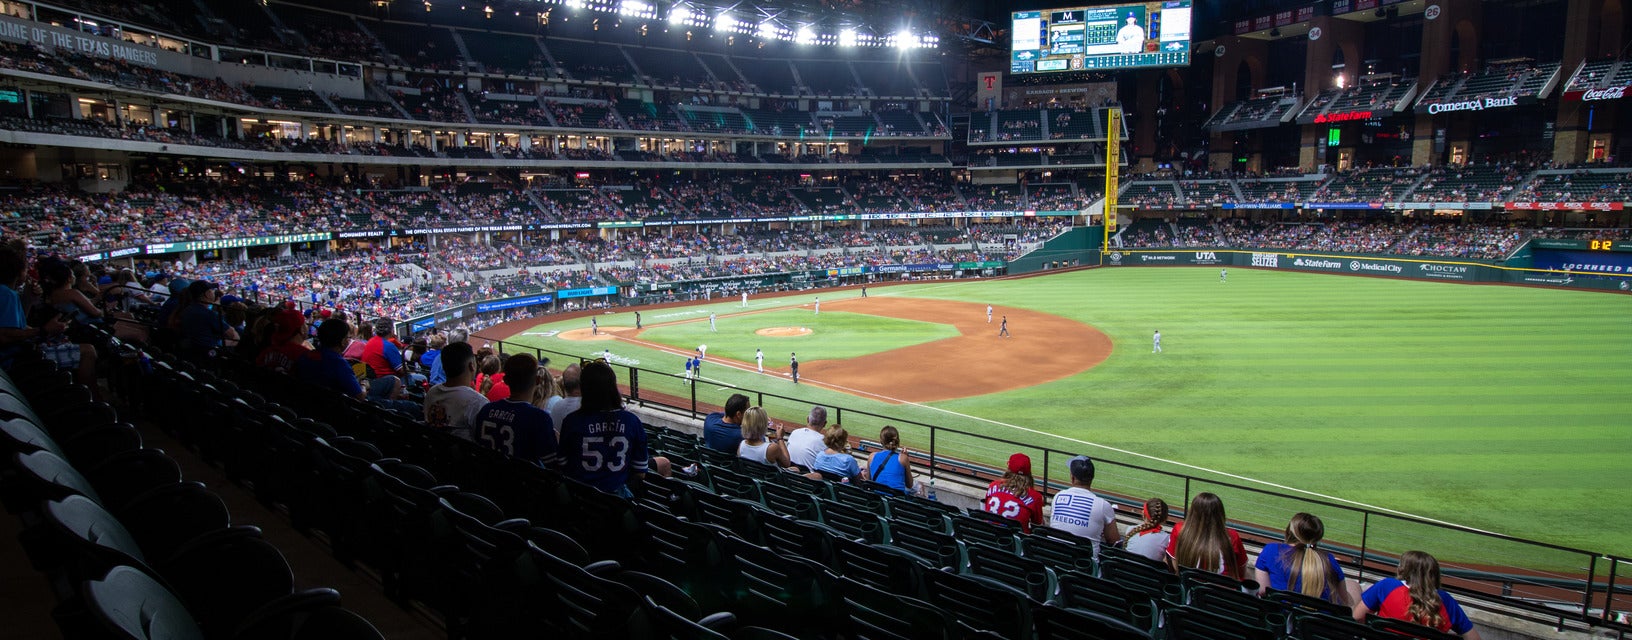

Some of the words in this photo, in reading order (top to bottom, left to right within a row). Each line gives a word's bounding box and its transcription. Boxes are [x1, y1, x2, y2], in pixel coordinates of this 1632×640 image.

[1063, 12, 1072, 20] M
[1427, 8, 1438, 17] 26
[1310, 29, 1320, 38] 34
[32, 27, 48, 44] OF
[51, 31, 73, 48] THE
[75, 36, 110, 56] TEXAS
[112, 44, 158, 66] RANGERS
[984, 76, 996, 90] T
[1485, 96, 1517, 108] Bank
[1591, 240, 1611, 250] 0:12
[1195, 252, 1216, 260] UTA
[1252, 257, 1277, 268] SELTZER
[1425, 264, 1467, 272] CHOCTAW
[1562, 263, 1622, 272] LOCKHEED
[481, 420, 514, 459] 53
[581, 436, 629, 472] 53
[988, 496, 1020, 518] 32
[1053, 514, 1088, 527] FREEDOM
